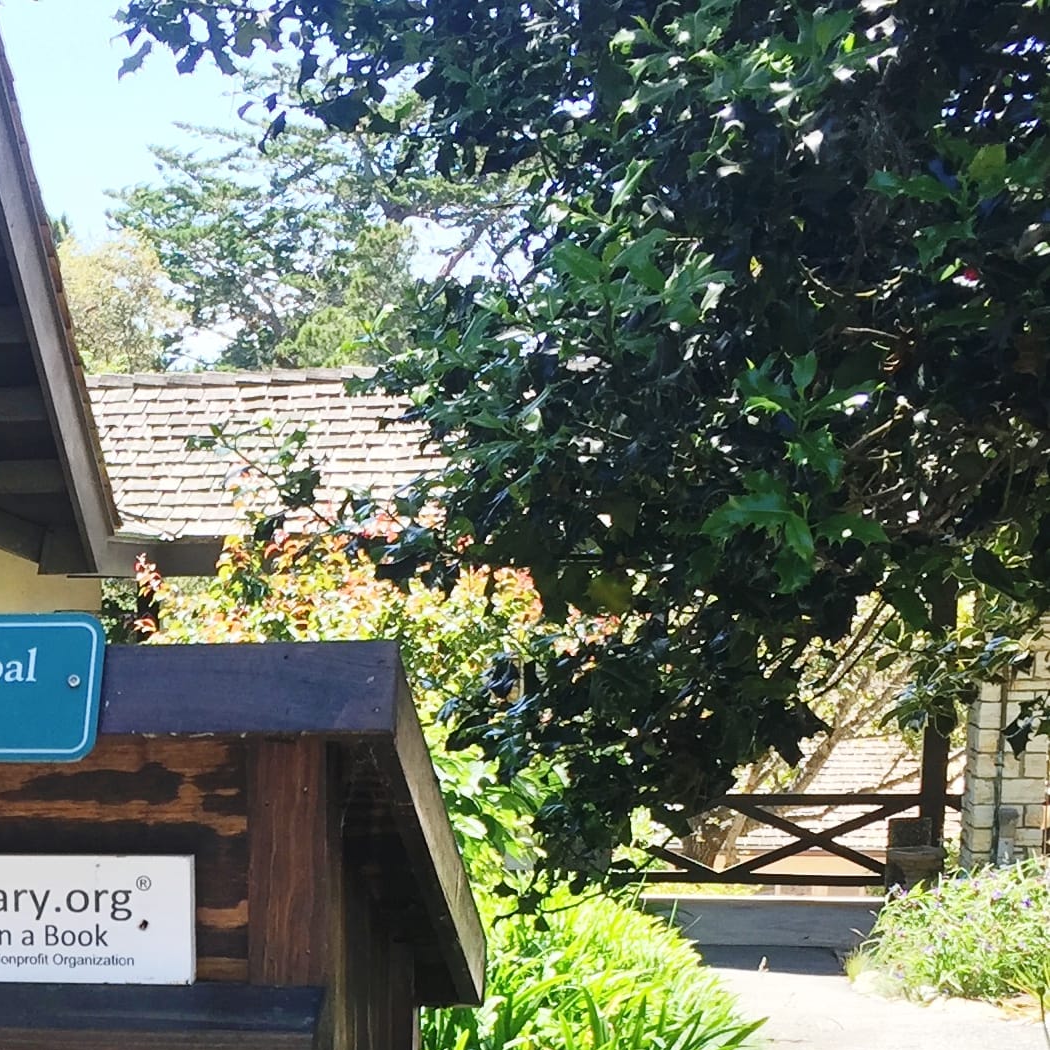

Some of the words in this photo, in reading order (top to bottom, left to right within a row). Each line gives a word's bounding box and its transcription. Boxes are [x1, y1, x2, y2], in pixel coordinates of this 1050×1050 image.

[21, 930, 35, 946] a
[45, 923, 109, 947] Book
[52, 953, 135, 968] Organization
